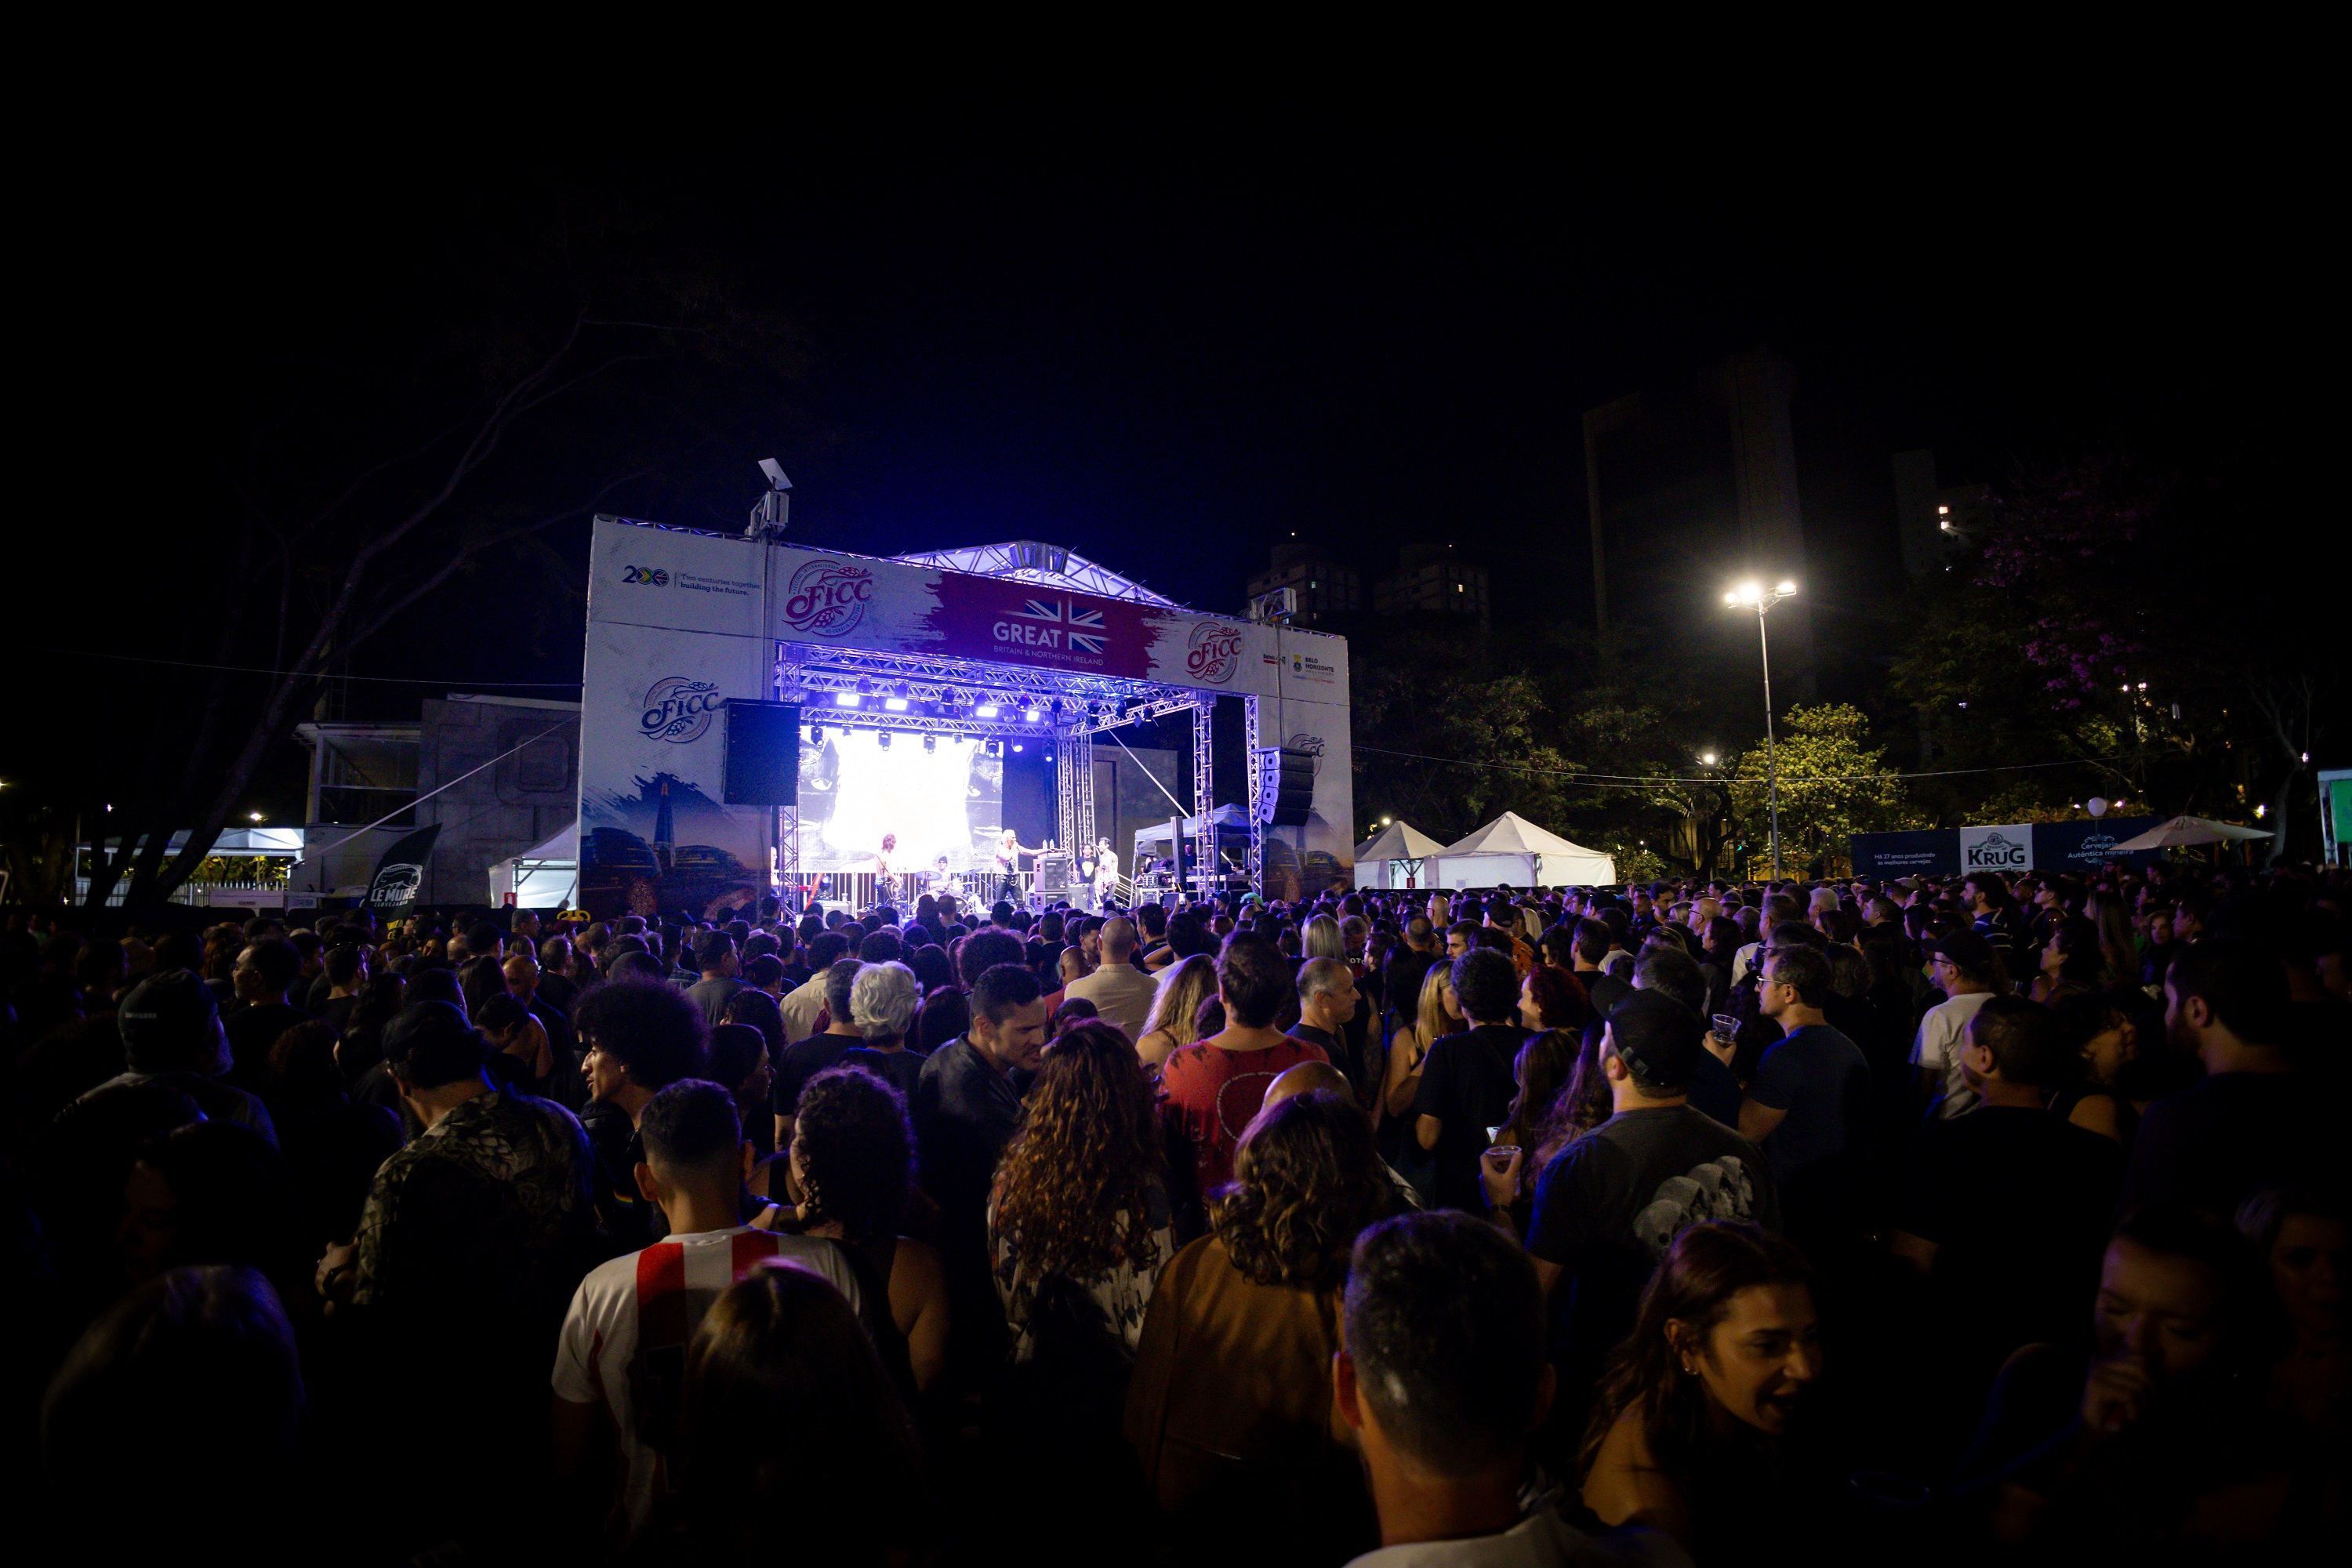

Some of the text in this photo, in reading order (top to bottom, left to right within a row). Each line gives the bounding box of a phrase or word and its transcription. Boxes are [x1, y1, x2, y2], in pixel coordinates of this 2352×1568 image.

[681, 581, 711, 592] building
[724, 587, 749, 596] future.
[698, 576, 731, 585] centuries
[786, 579, 872, 619] FICC
[993, 621, 1062, 648] GREAT
[993, 645, 1022, 655] BRITAIN
[1032, 651, 1072, 662] NORTHERN
[1073, 655, 1103, 666] IRELAND
[1188, 637, 1241, 669] FICC
[1305, 663, 1334, 673] HORIZONTE
[642, 692, 718, 729] FICC
[2067, 850, 2103, 858] Autêntica
